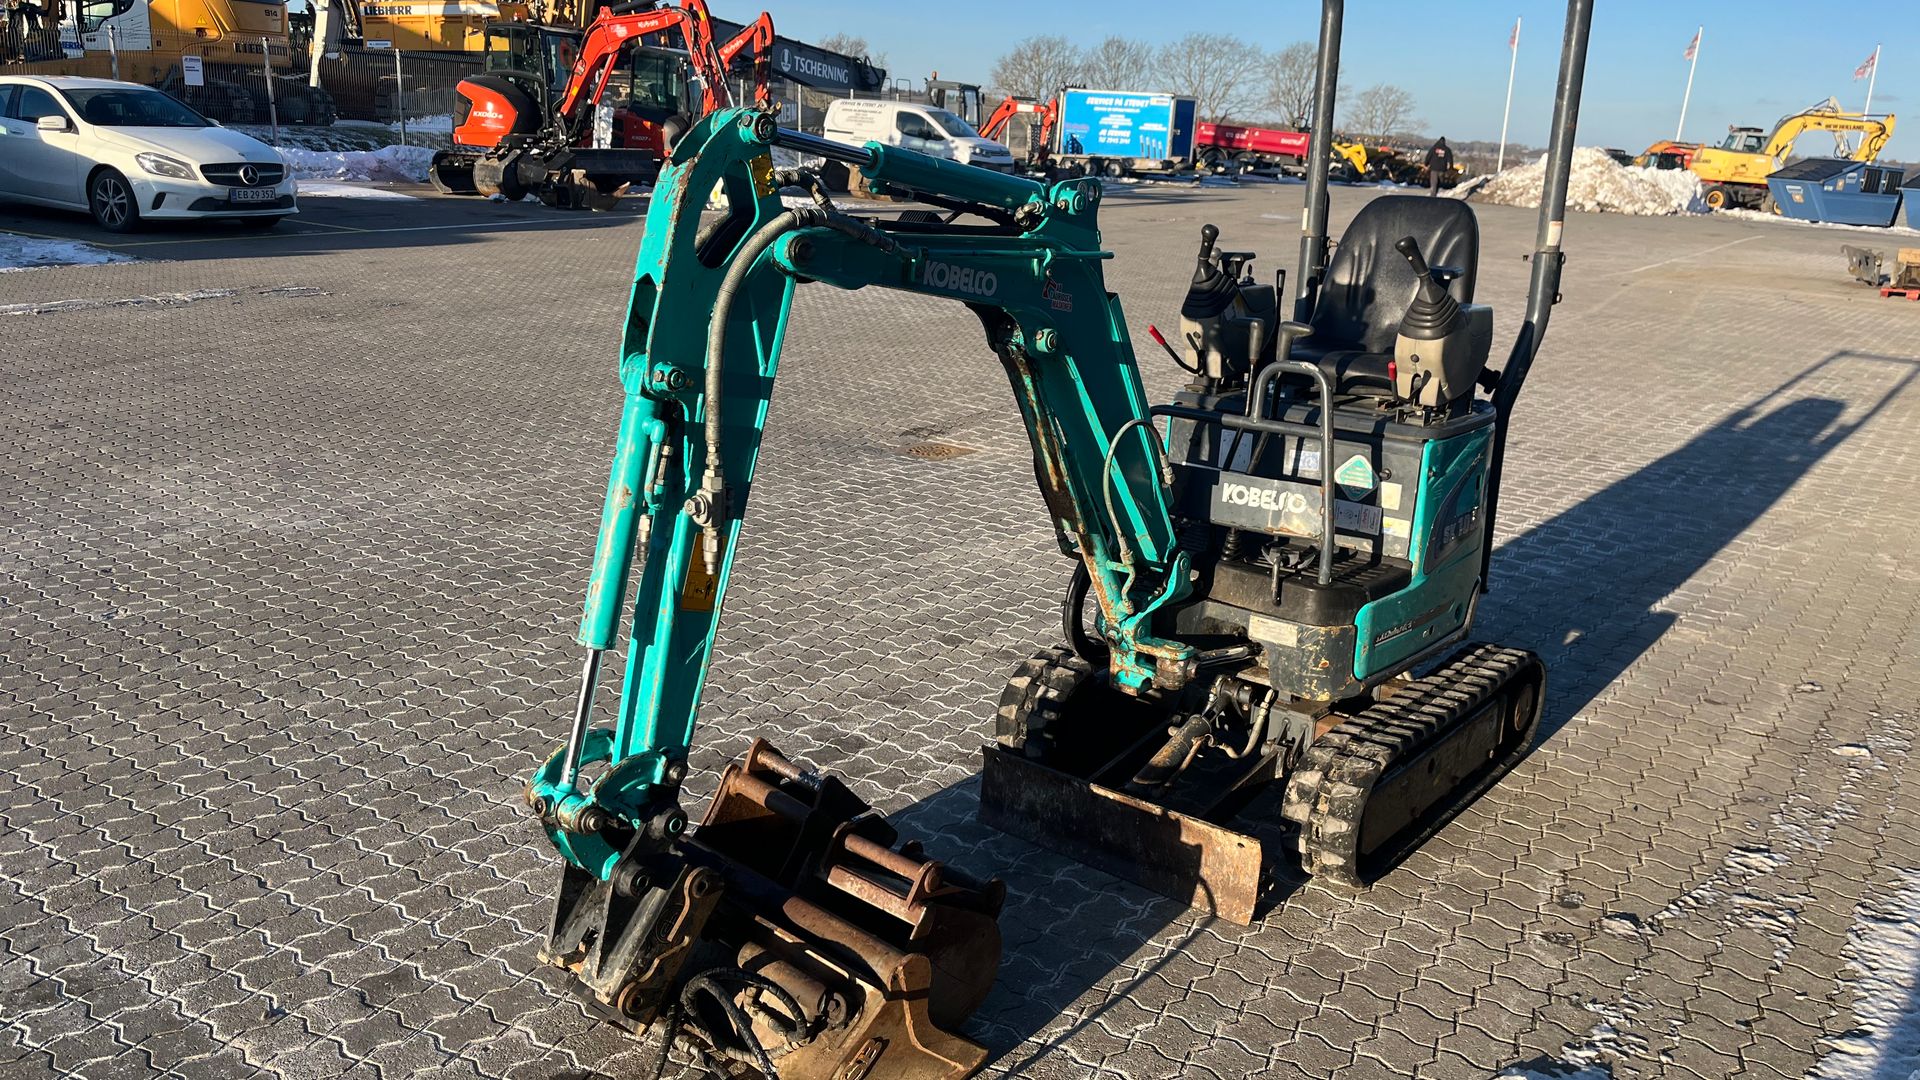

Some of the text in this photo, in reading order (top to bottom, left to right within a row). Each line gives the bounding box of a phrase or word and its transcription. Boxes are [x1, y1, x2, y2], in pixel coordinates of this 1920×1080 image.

[364, 6, 412, 16] LIEBHERR
[794, 56, 849, 84] TSCHERNING
[237, 190, 274, 199] EB 29 352
[923, 260, 998, 297] KOBELCO
[1221, 482, 1308, 514] KOBELCO
